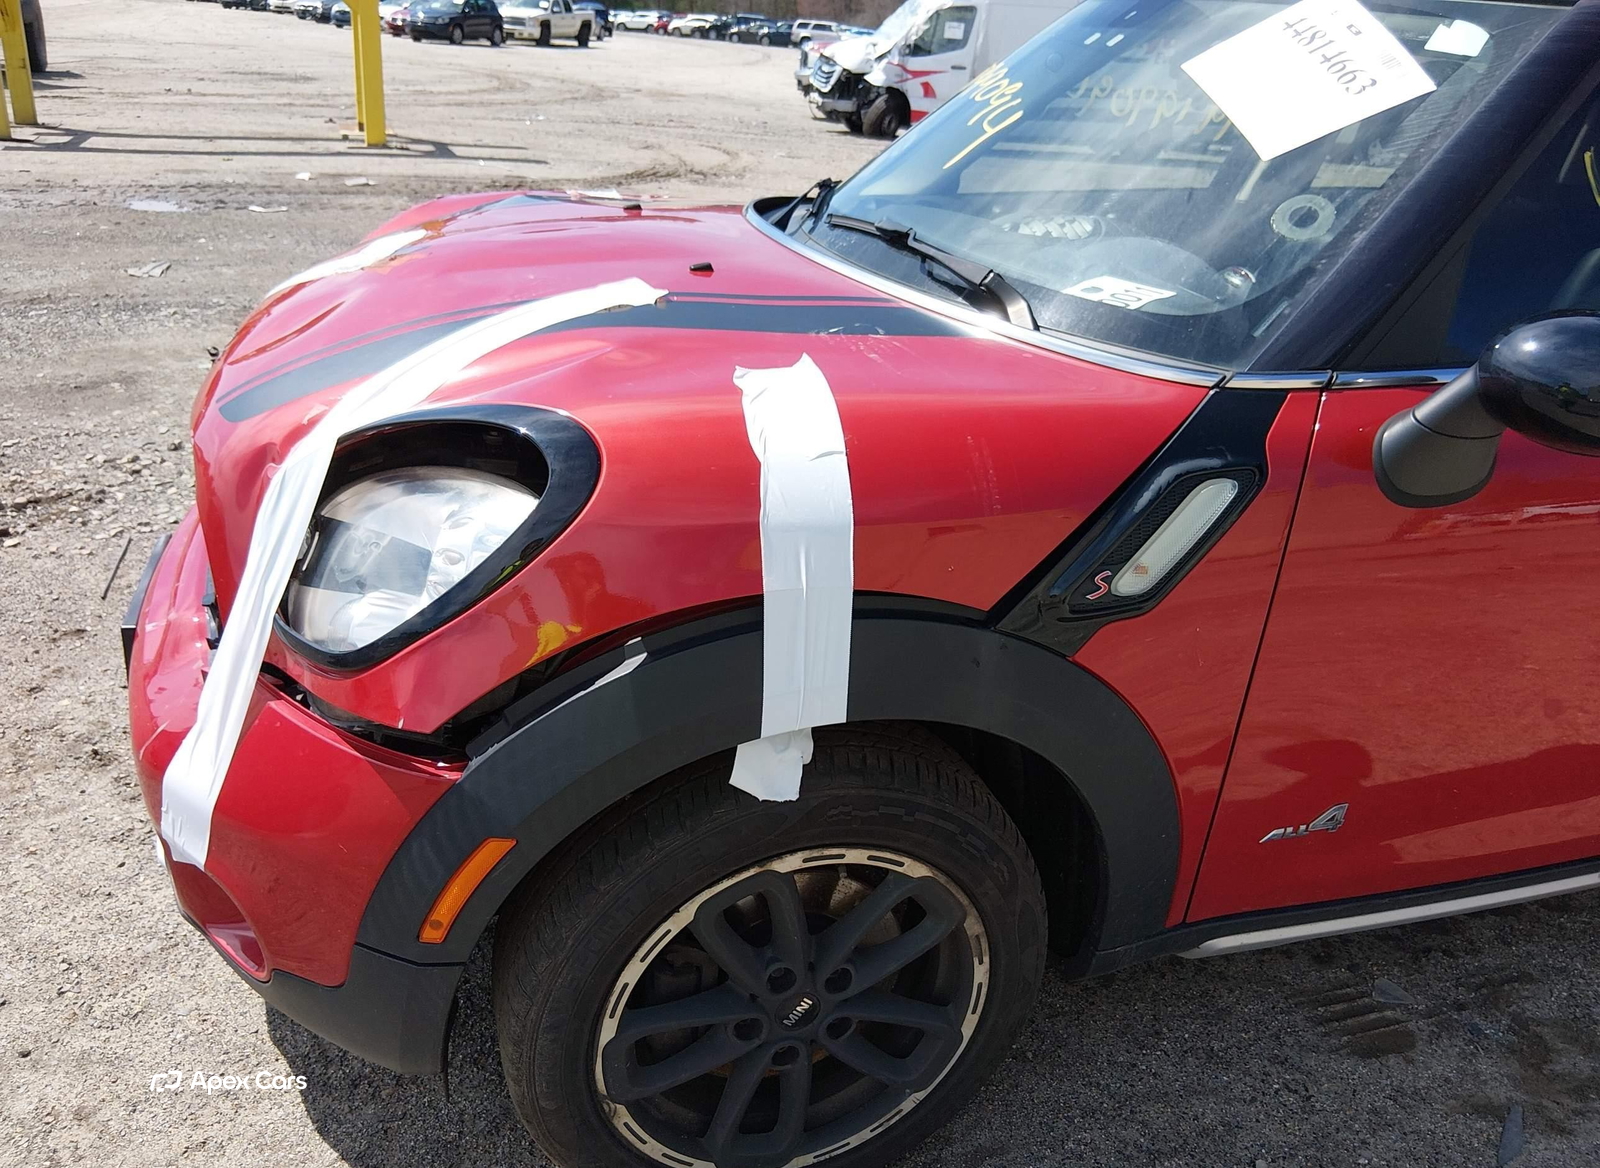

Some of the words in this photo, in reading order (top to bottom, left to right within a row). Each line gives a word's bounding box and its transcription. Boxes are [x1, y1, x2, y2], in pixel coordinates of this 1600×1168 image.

[1282, 17, 1378, 95] 44814663
[1085, 570, 1112, 600] S
[1259, 803, 1349, 843] ALL4
[782, 997, 813, 1027] MINI
